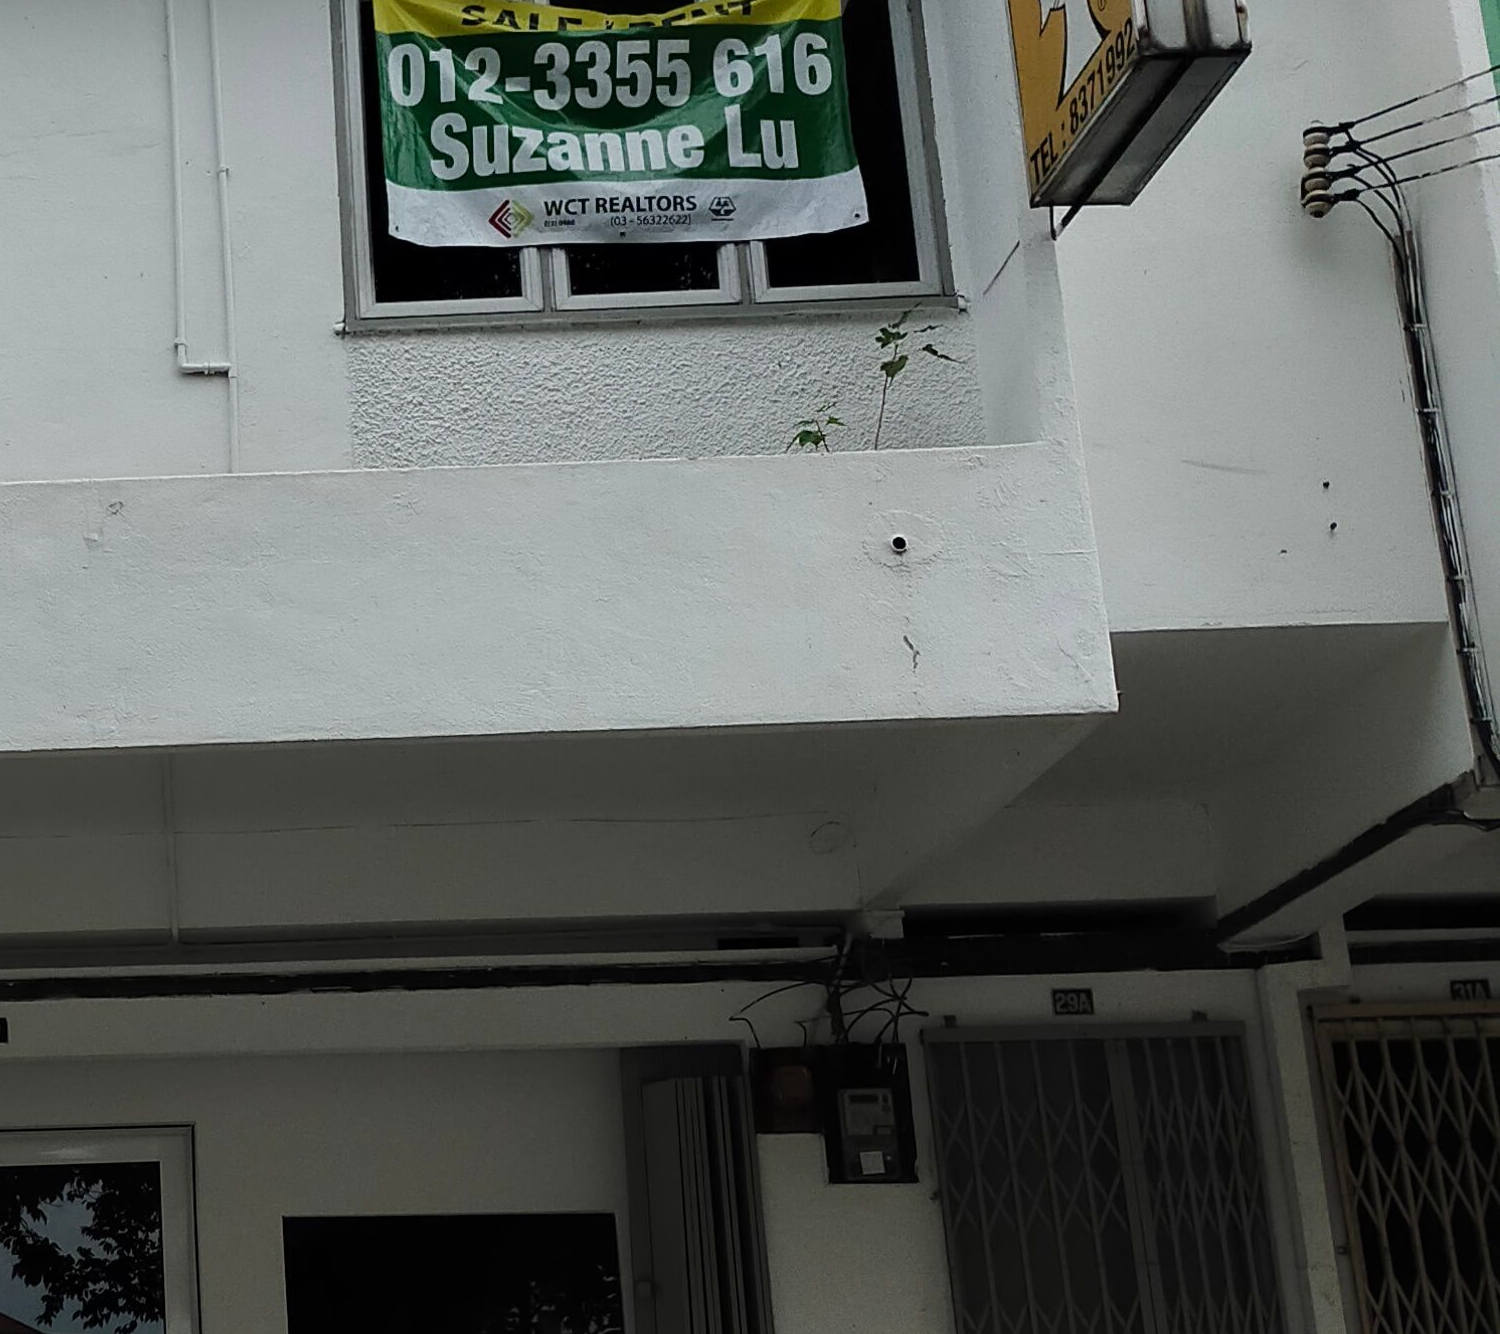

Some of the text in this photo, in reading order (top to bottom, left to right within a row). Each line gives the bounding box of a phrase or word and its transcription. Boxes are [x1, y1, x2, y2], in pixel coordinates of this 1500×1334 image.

[387, 33, 832, 111] 012-3355 616
[1069, 17, 1135, 134] 8371992
[430, 104, 799, 180] Suzanne Lu
[544, 195, 697, 216] WCT REALTORS
[1055, 993, 1091, 1013] 29A
